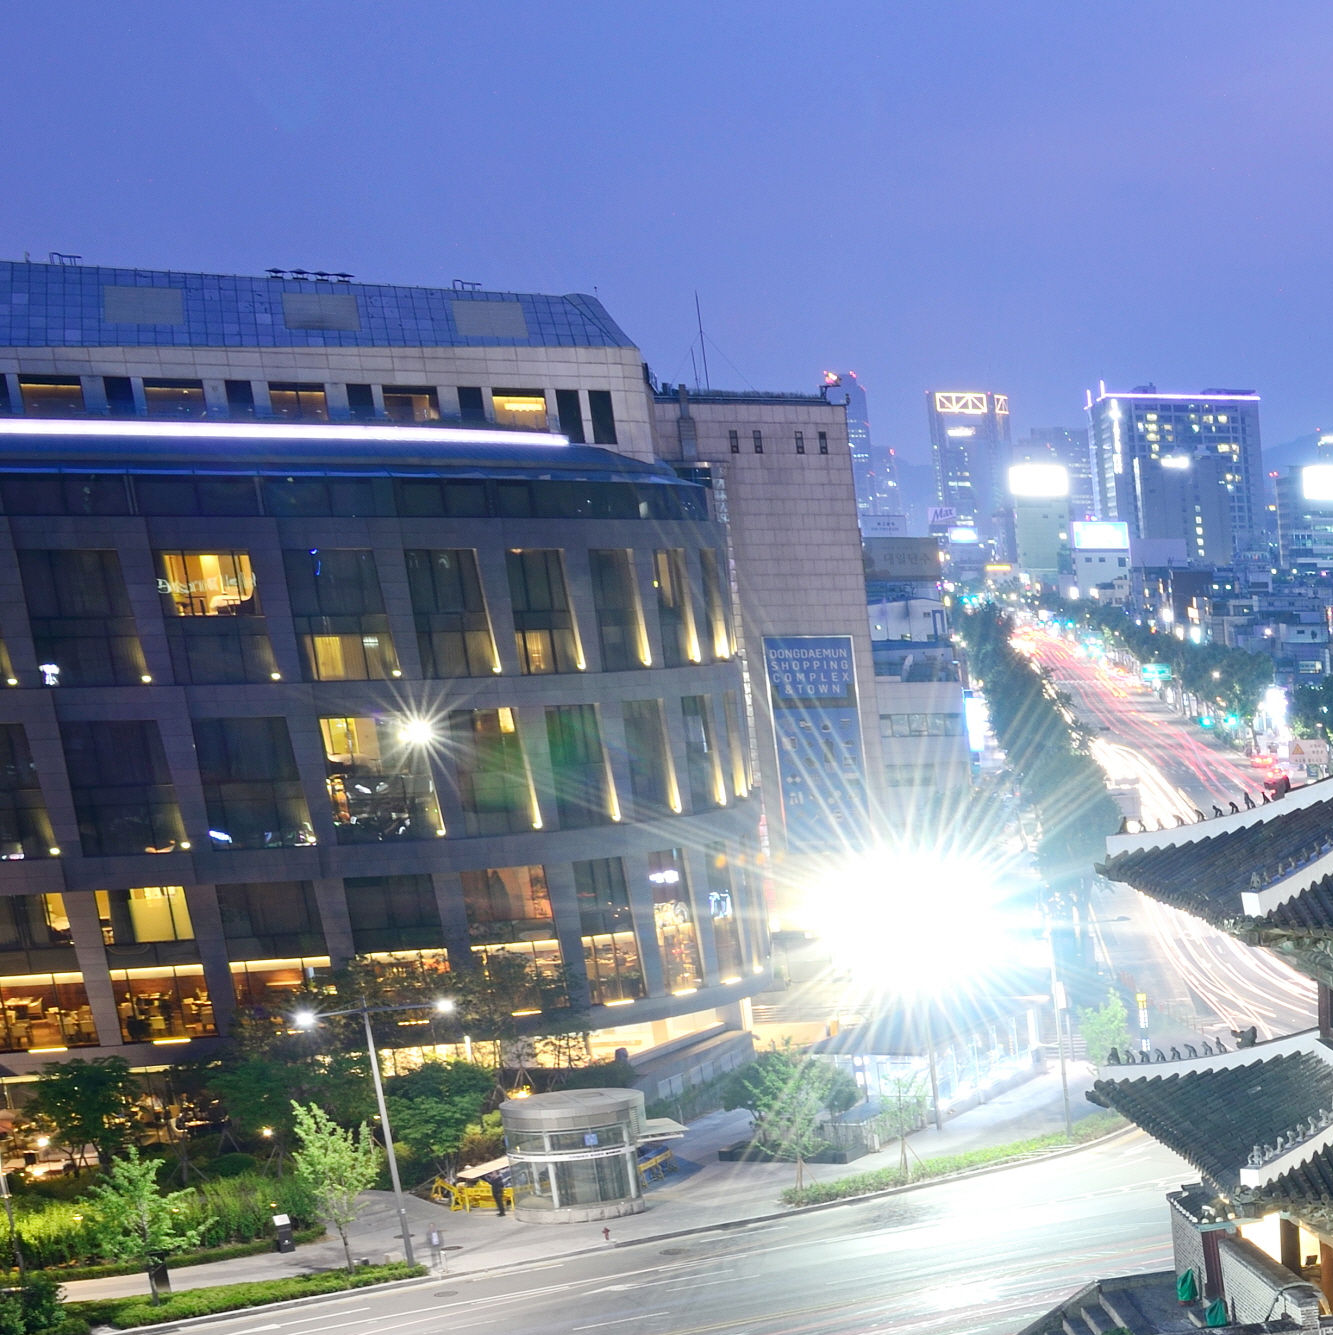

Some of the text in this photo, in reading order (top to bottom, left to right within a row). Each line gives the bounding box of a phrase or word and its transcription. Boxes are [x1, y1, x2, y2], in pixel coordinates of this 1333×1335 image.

[931, 508, 954, 524] Max
[769, 648, 847, 660] DONGDAEMUN
[771, 660, 849, 671] SHOPPING
[773, 672, 850, 683] COMPLEX
[784, 684, 841, 695] & TOWN
